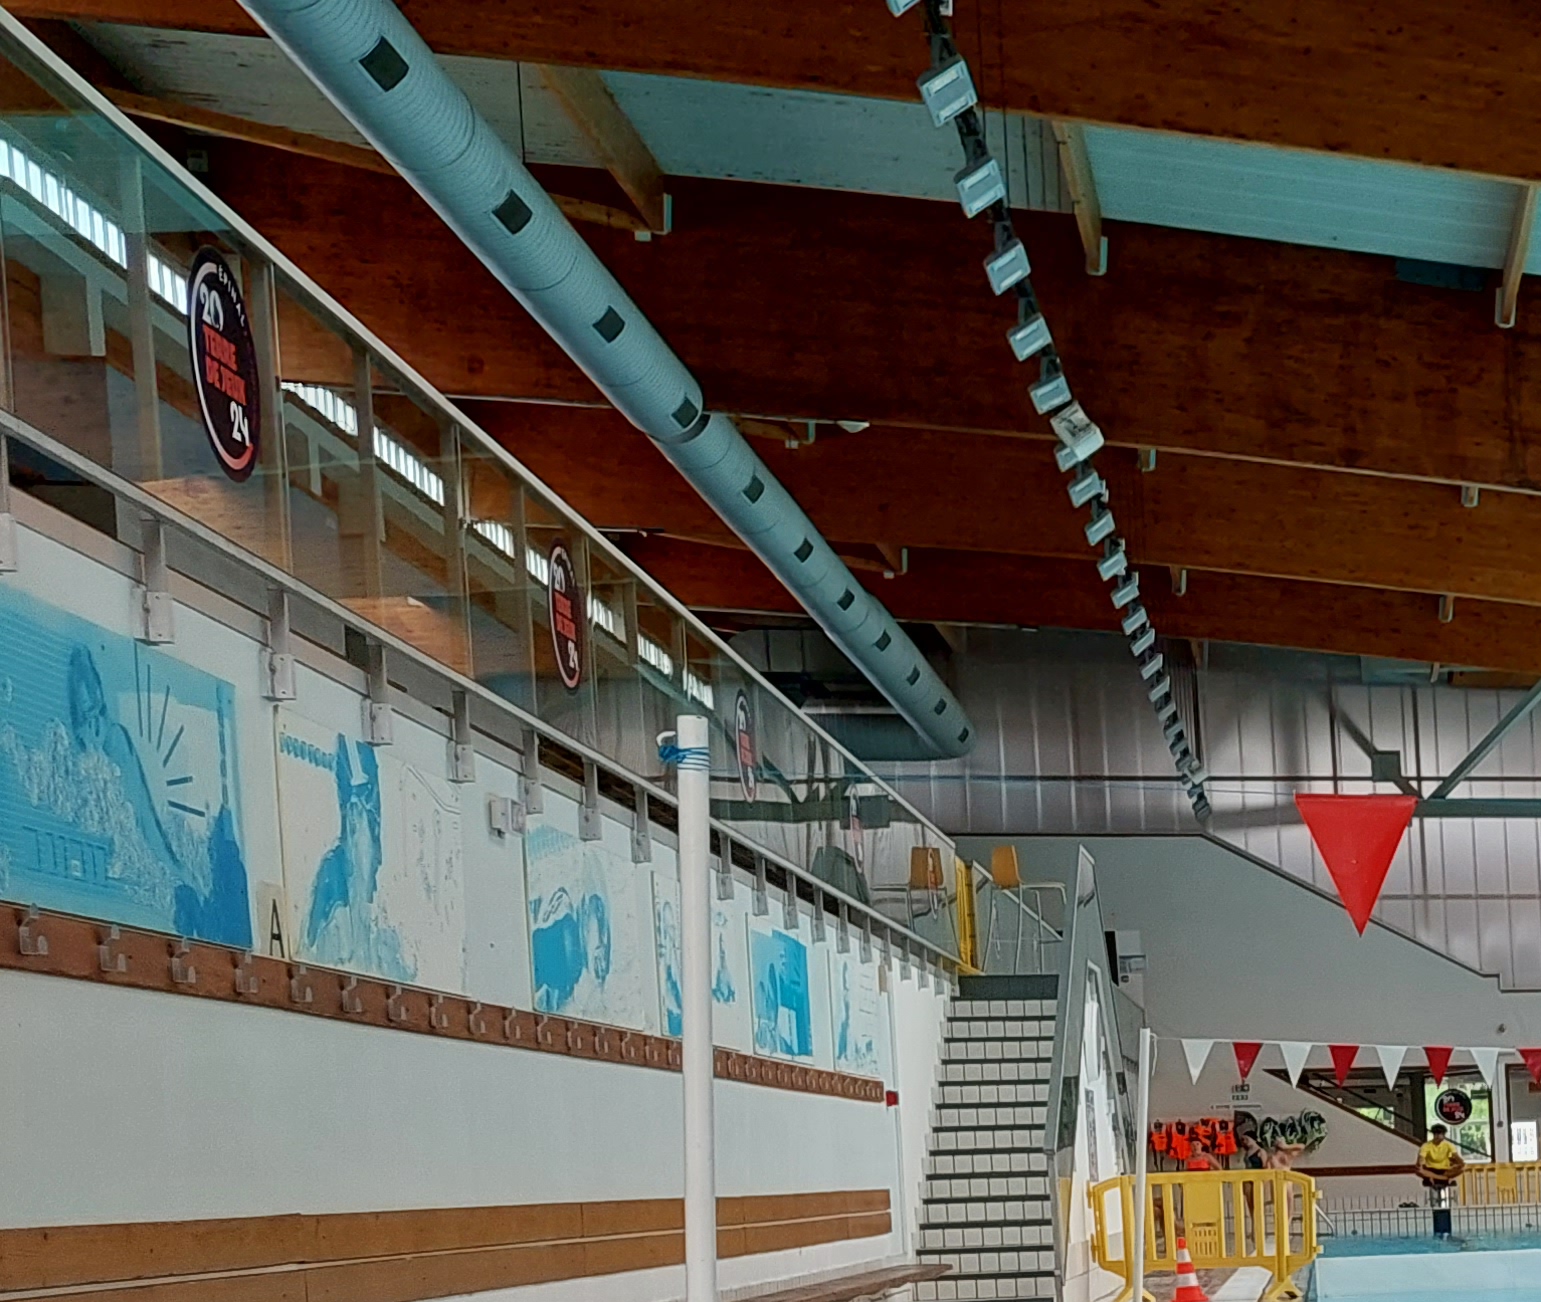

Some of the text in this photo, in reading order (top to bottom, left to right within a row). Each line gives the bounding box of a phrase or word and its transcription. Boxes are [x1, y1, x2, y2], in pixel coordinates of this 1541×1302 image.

[200, 283, 224, 331] 20
[230, 401, 250, 447] 24
[269, 899, 285, 958] A
